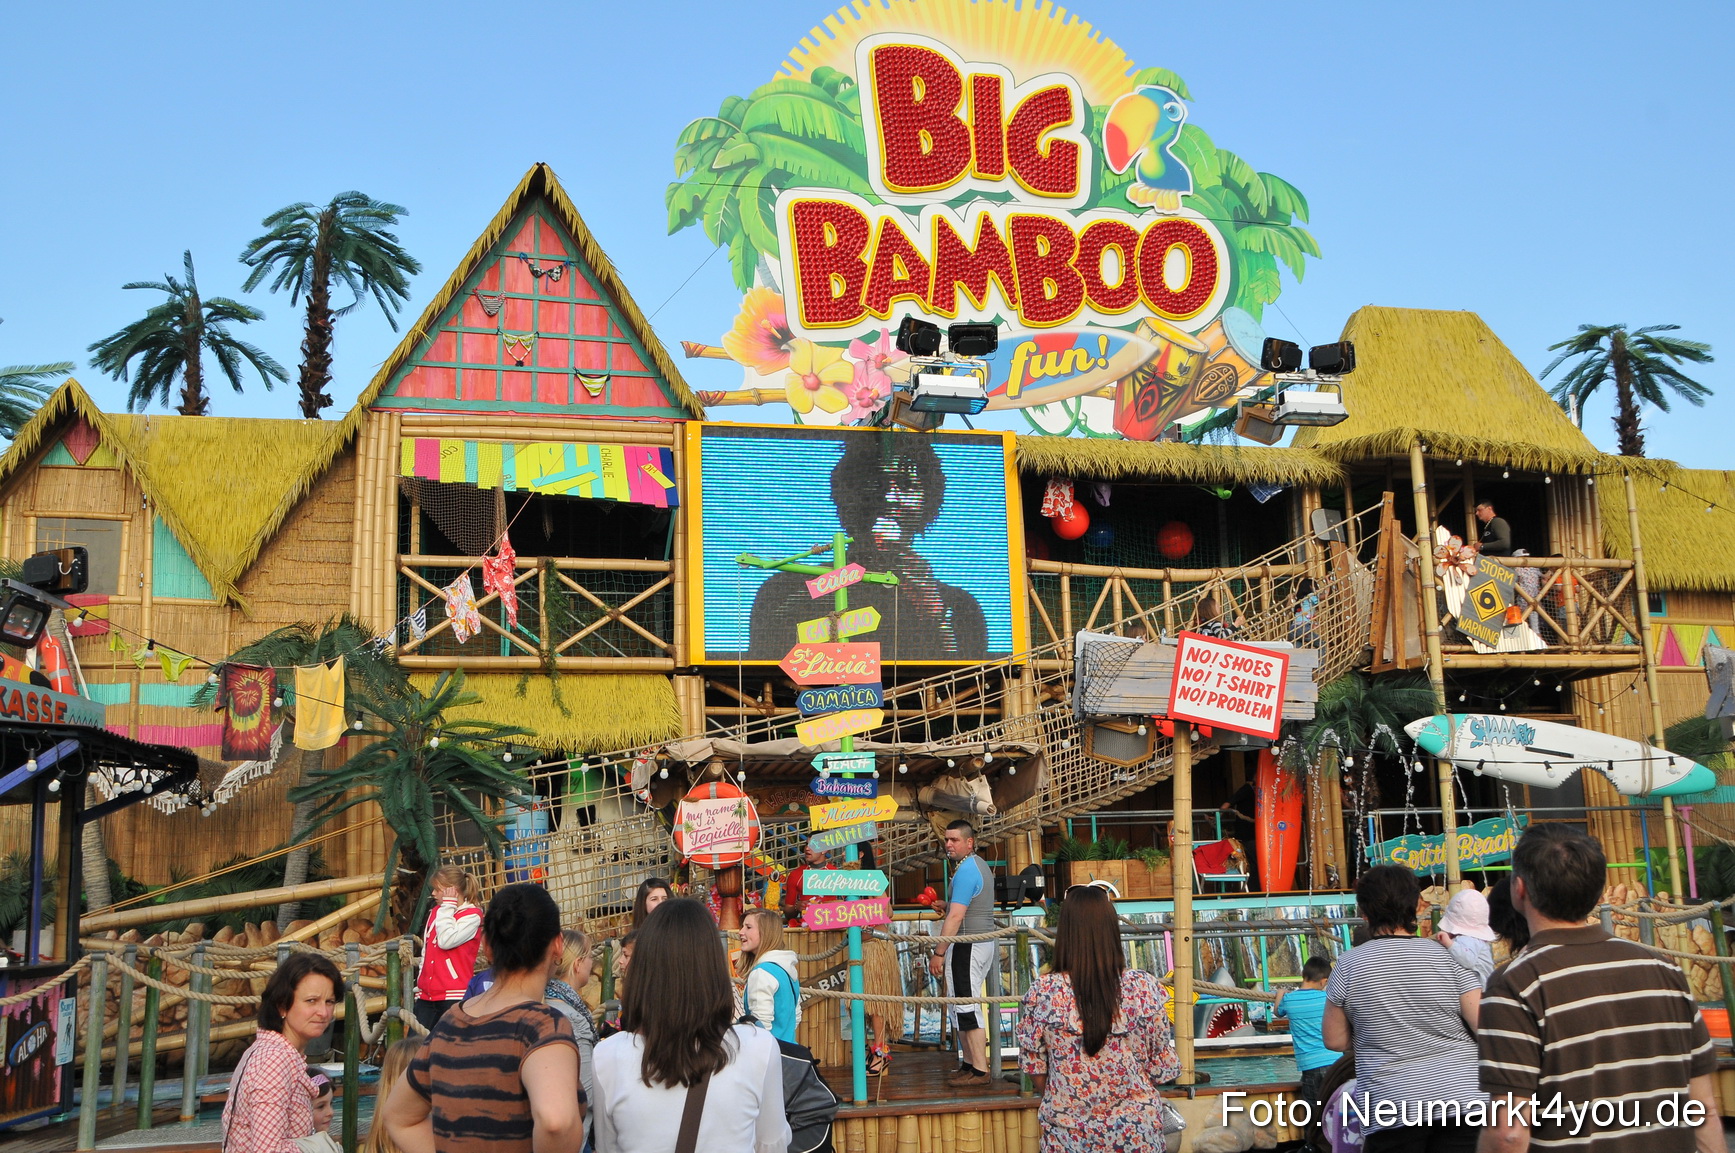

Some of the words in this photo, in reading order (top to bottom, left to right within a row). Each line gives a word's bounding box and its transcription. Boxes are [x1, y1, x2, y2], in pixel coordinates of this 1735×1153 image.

[868, 43, 1080, 197] BIG
[787, 199, 1219, 328] BAMBOO
[1006, 335, 1109, 400] fun!
[601, 447, 614, 479] CHARLIE
[1479, 558, 1515, 586] STORM
[1457, 615, 1501, 646] WARNING
[1186, 647, 1220, 668] NO!
[1219, 653, 1273, 678] SHOES
[1181, 666, 1212, 686] NO!
[1216, 673, 1276, 700] T-SHIRT
[1177, 686, 1207, 706] NO!
[1206, 691, 1273, 721] PROBLEM
[804, 712, 873, 742] TOBAGO
[823, 755, 872, 770] BEACH
[816, 778, 873, 796] Bahamas
[704, 815, 716, 827] is
[705, 804, 736, 817] name
[820, 800, 884, 825] Miami
[1456, 829, 1516, 861] Beach
[806, 872, 881, 893] California
[836, 902, 884, 925] BARTH
[817, 969, 847, 992] BAR
